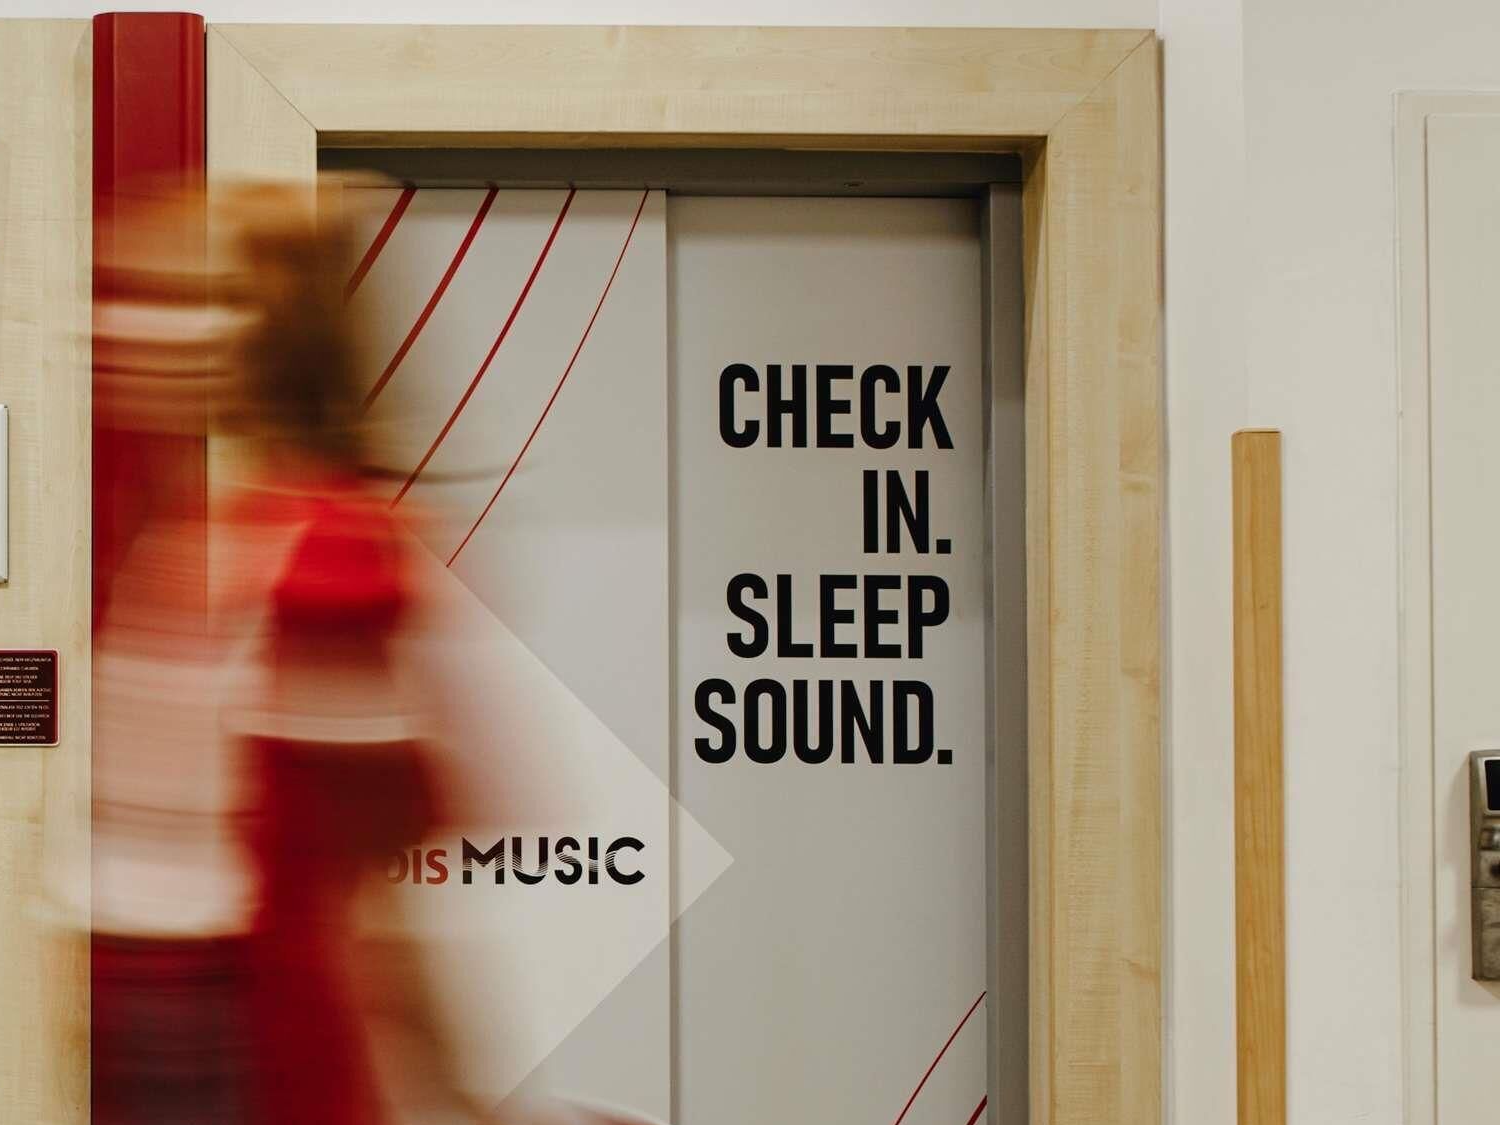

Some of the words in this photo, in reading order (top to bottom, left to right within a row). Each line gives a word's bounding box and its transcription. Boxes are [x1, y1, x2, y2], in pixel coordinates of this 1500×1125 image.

[719, 363, 955, 450] CHECK
[862, 469, 952, 555] IN.
[726, 572, 951, 659] SLEEP
[694, 678, 953, 765] SOUND.
[462, 836, 646, 885] MUSIC
